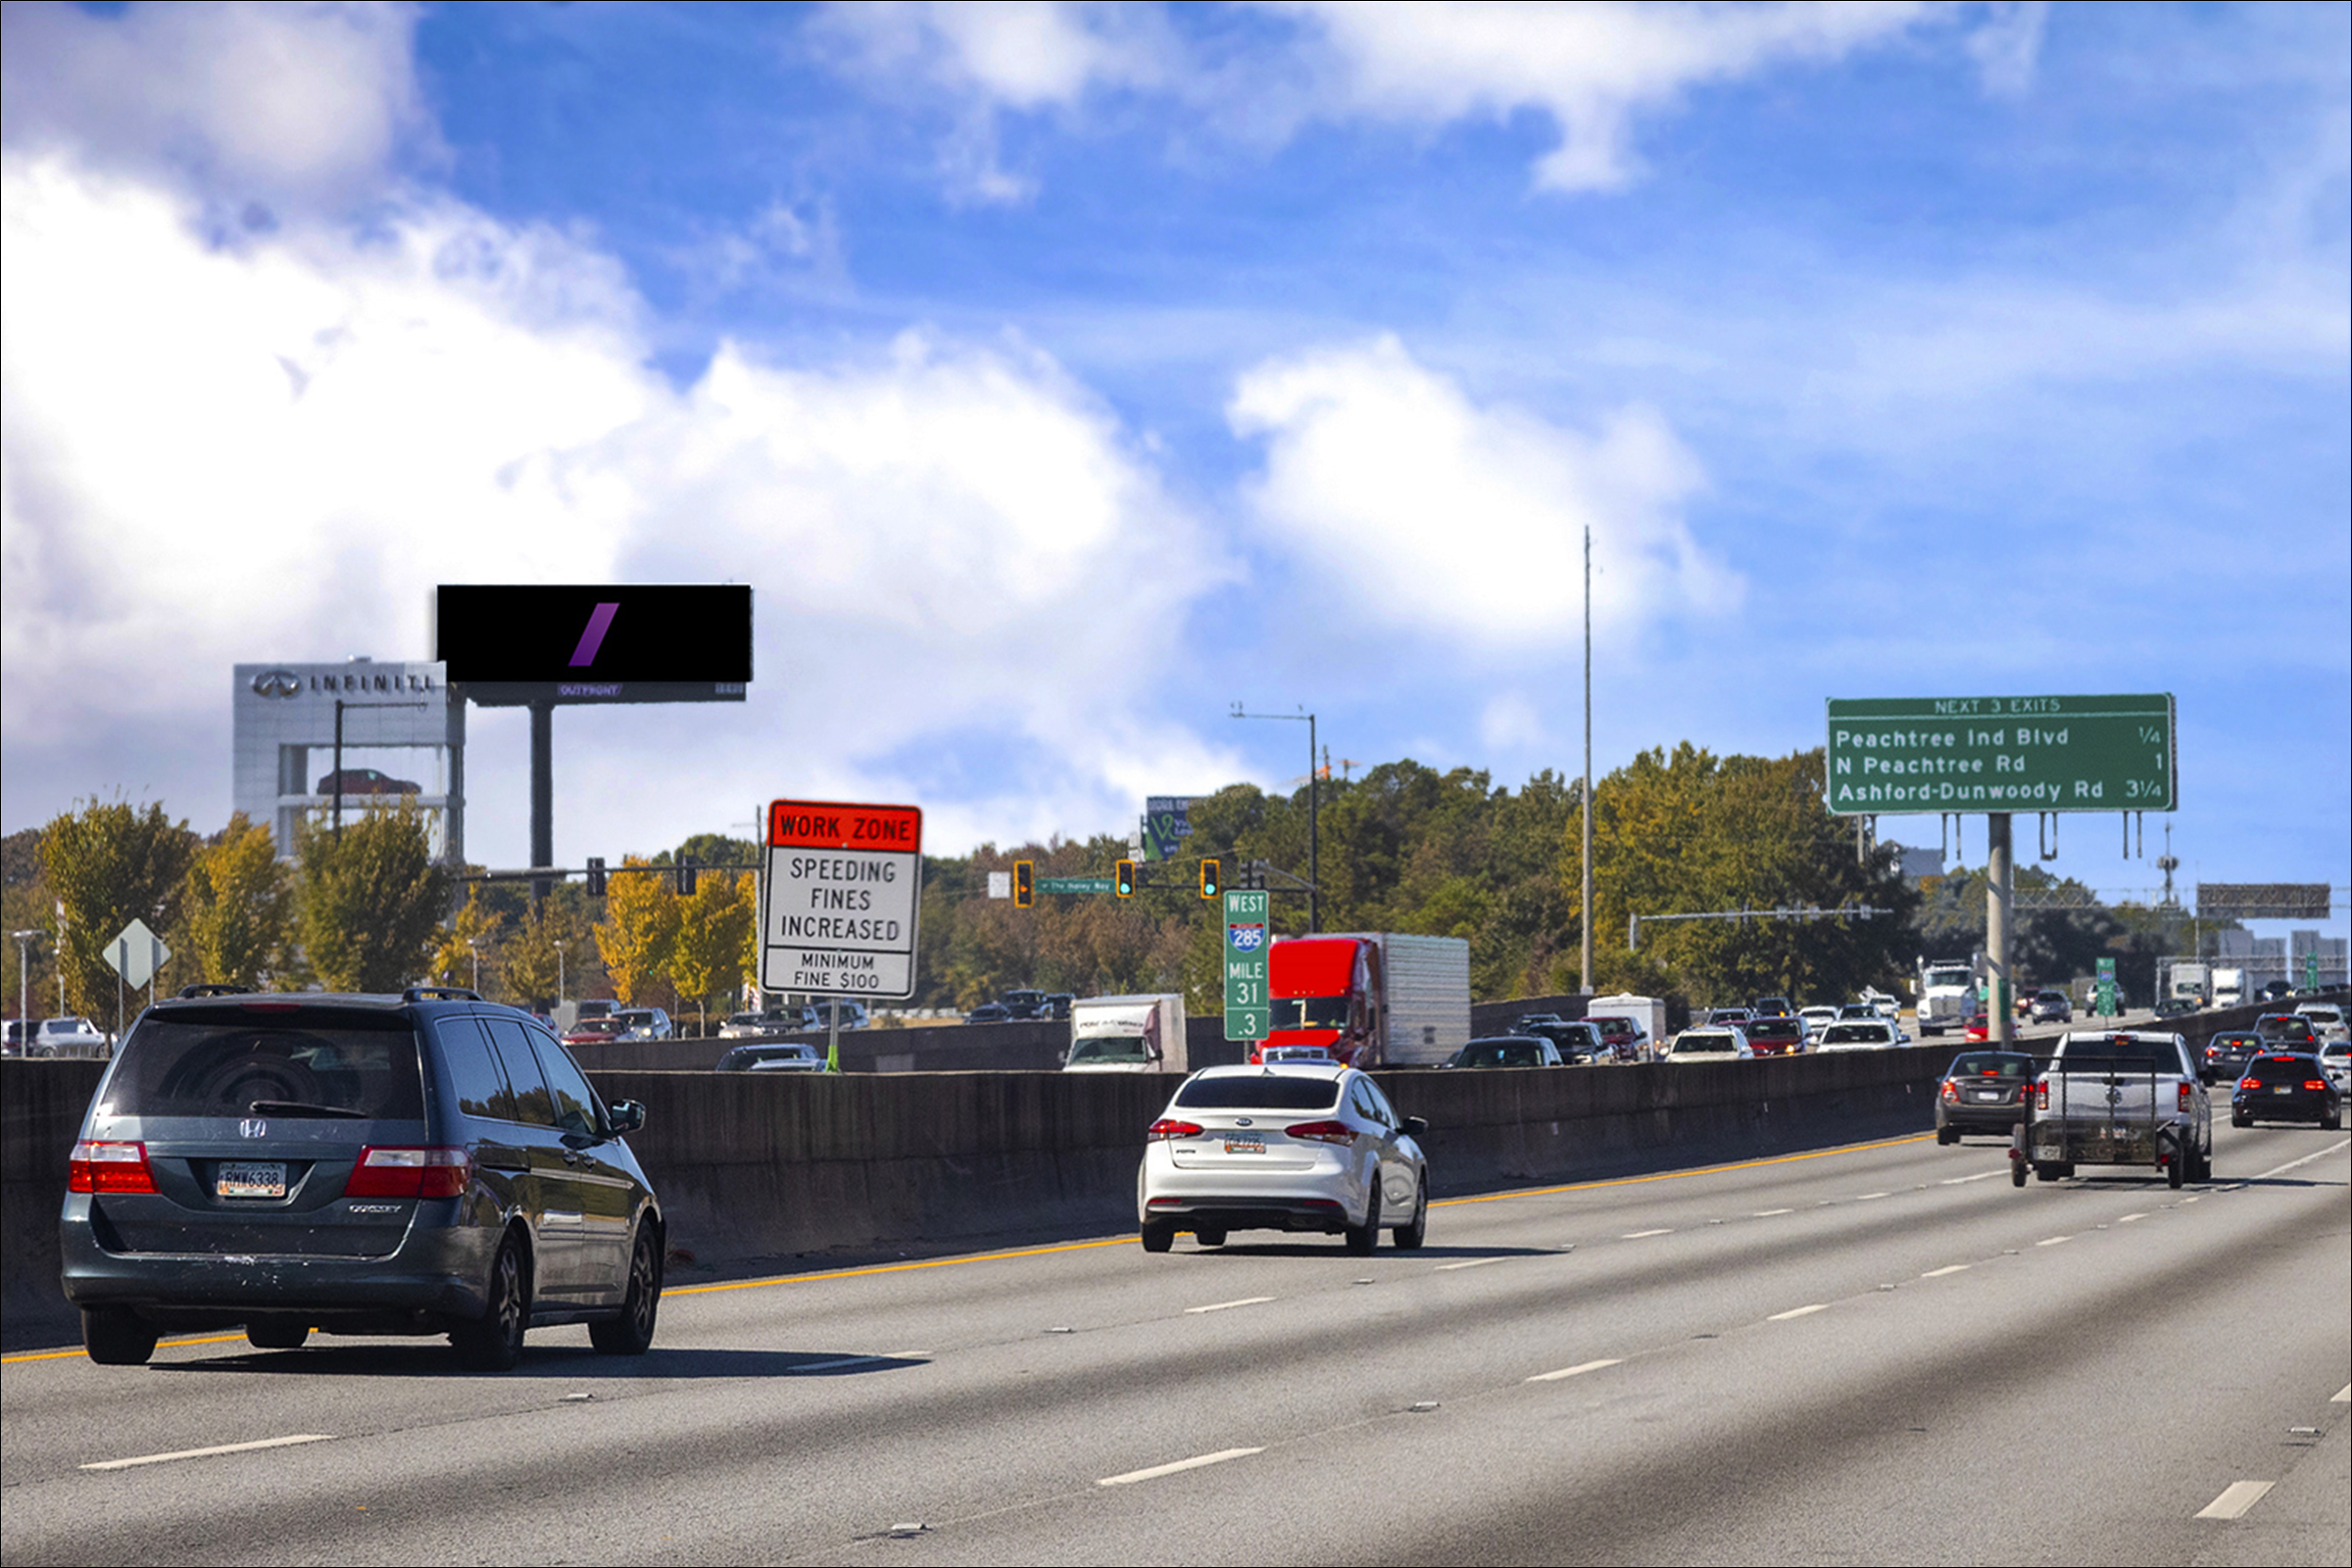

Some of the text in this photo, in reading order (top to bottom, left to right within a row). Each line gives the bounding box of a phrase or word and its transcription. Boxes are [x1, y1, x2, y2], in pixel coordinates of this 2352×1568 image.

[310, 674, 430, 691] INFINITI
[1935, 699, 2061, 714] NEXT 3 EXITS
[1836, 730, 1956, 748] Peachtree
[1968, 728, 2005, 746] Ind
[2017, 727, 2069, 745] Blvd
[1836, 753, 2163, 774] N Peachtree Rd 1
[1838, 782, 2061, 803] Ashford-Dunwoody
[2075, 780, 2103, 798] Rd
[780, 815, 911, 841] WORK ZONE
[790, 858, 896, 883] SPEEDING
[810, 888, 871, 910] FINES
[1229, 895, 1264, 911] WEST
[781, 915, 901, 941] INCREASED
[1234, 930, 1261, 947] 285
[802, 953, 875, 970] MINIMUM
[1229, 962, 1263, 979] MILE
[794, 971, 879, 989] FINE $100
[1237, 983, 1257, 1004] 31
